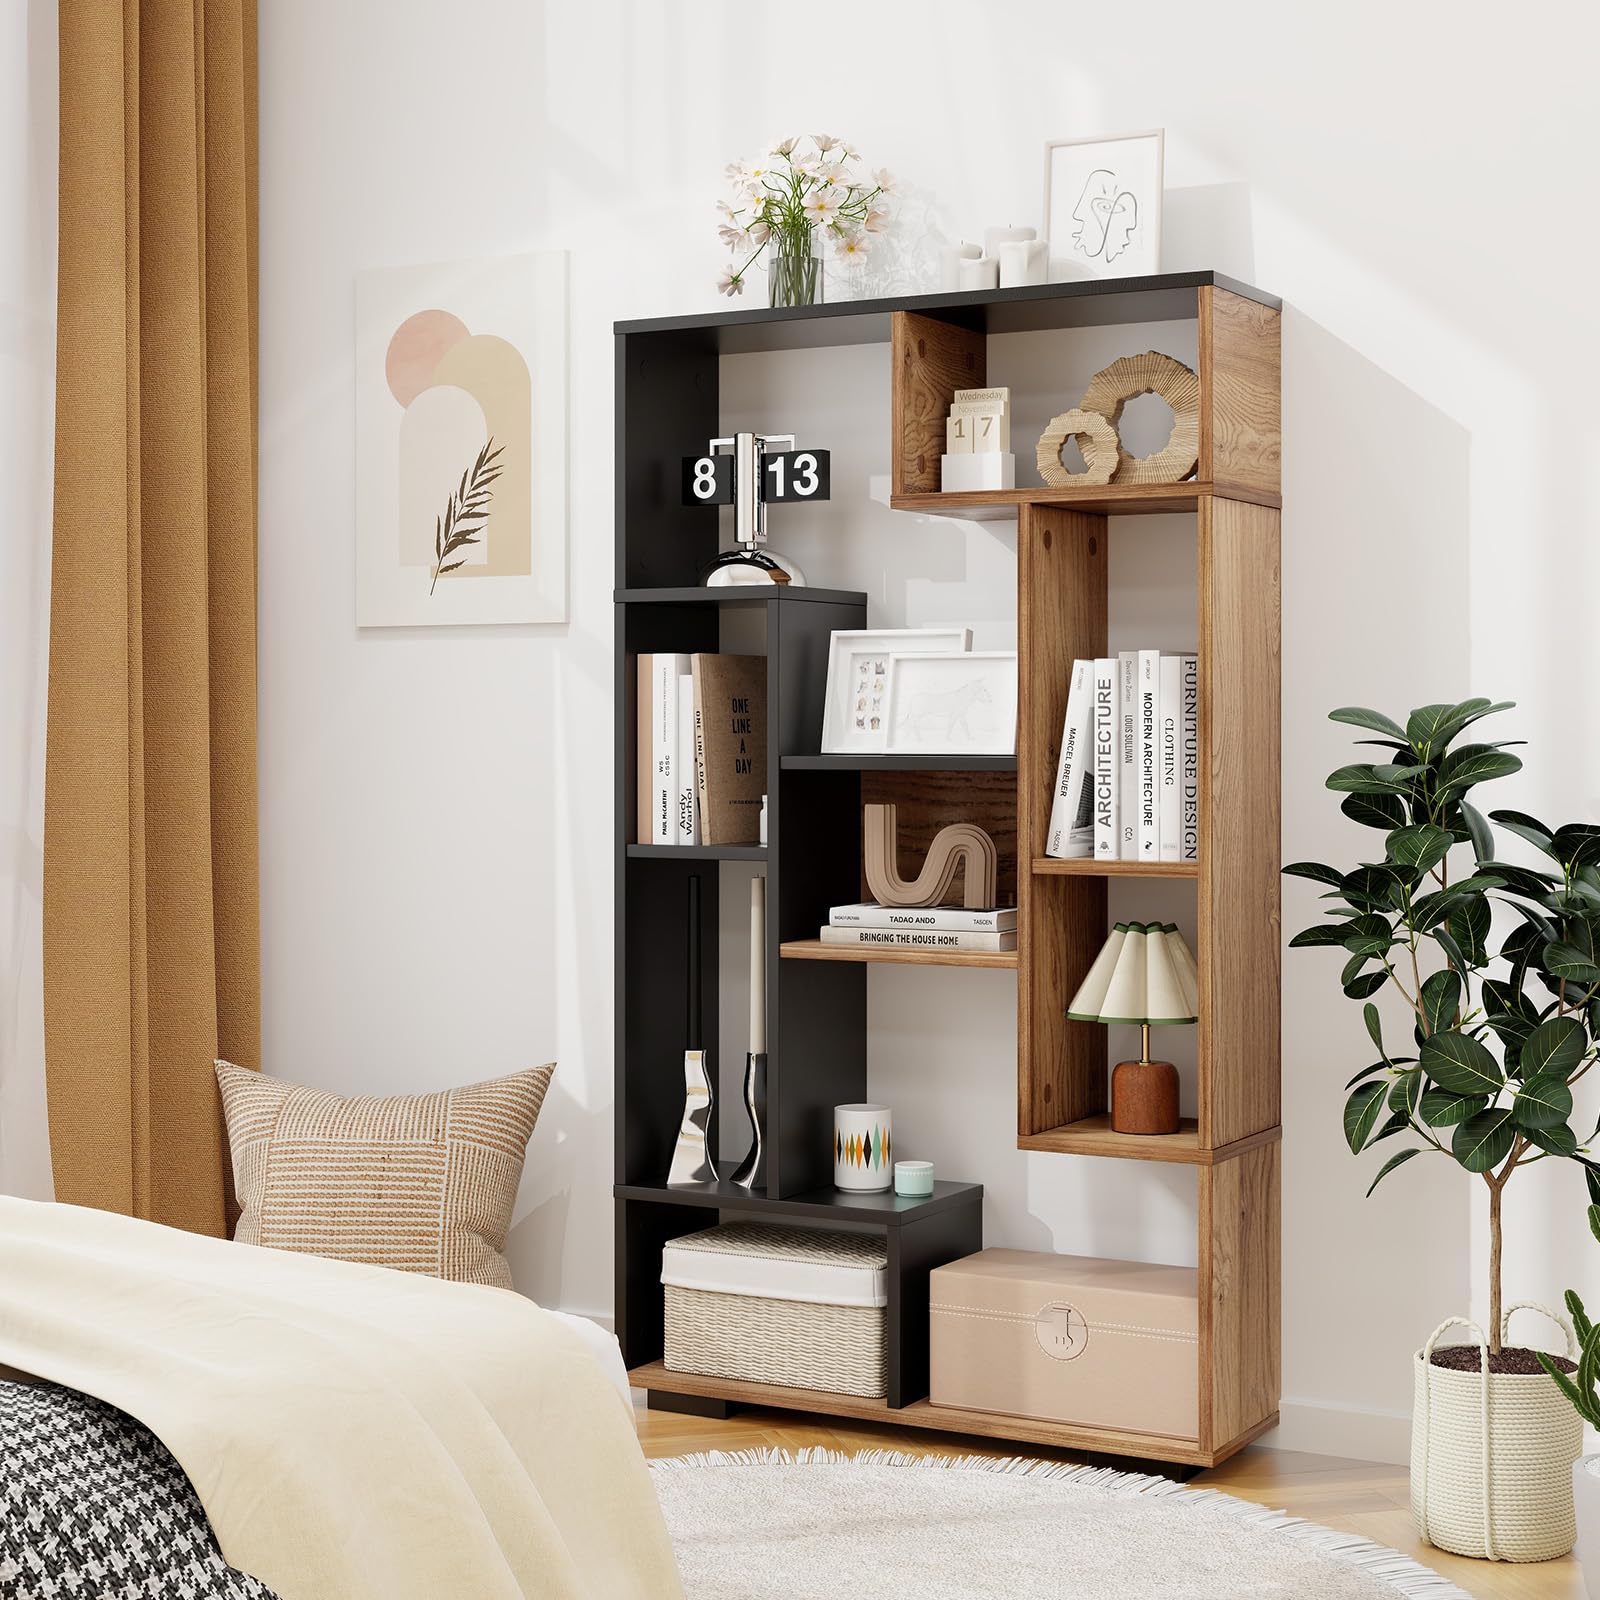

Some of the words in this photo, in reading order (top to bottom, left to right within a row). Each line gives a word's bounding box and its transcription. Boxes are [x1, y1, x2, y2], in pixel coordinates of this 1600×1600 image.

[959, 391, 1003, 400] Wednesday
[954, 418, 965, 438] 1
[980, 416, 993, 438] 7
[692, 457, 717, 500] 8
[767, 453, 819, 498] 13
[731, 698, 749, 714] ONE
[1143, 692, 1153, 740] MODERN
[1184, 660, 1197, 778] FURNITURE
[732, 718, 751, 734] LINE
[1124, 714, 1133, 732] LOUIS
[740, 738, 746, 754] A
[1065, 727, 1077, 760] MARCEL
[1098, 678, 1112, 828] ARCHITECTURE
[1124, 733, 1133, 764] SULLIVAN
[1164, 718, 1175, 786] CLOTHING
[658, 760, 664, 773] WS
[735, 759, 752, 774] DAY
[1060, 763, 1072, 797] BREUER
[1143, 742, 1153, 826] ARCHITECTURE
[679, 794, 687, 829] Andy
[1184, 785, 1197, 860] DESIGN
[1124, 827, 1133, 842] CCA
[889, 915, 914, 924] TADAO
[915, 916, 936, 925] ANDO
[859, 932, 895, 944] BRINGING
[896, 934, 910, 944] THE
[912, 934, 936, 945] HOUSE
[938, 935, 959, 946] HOME
